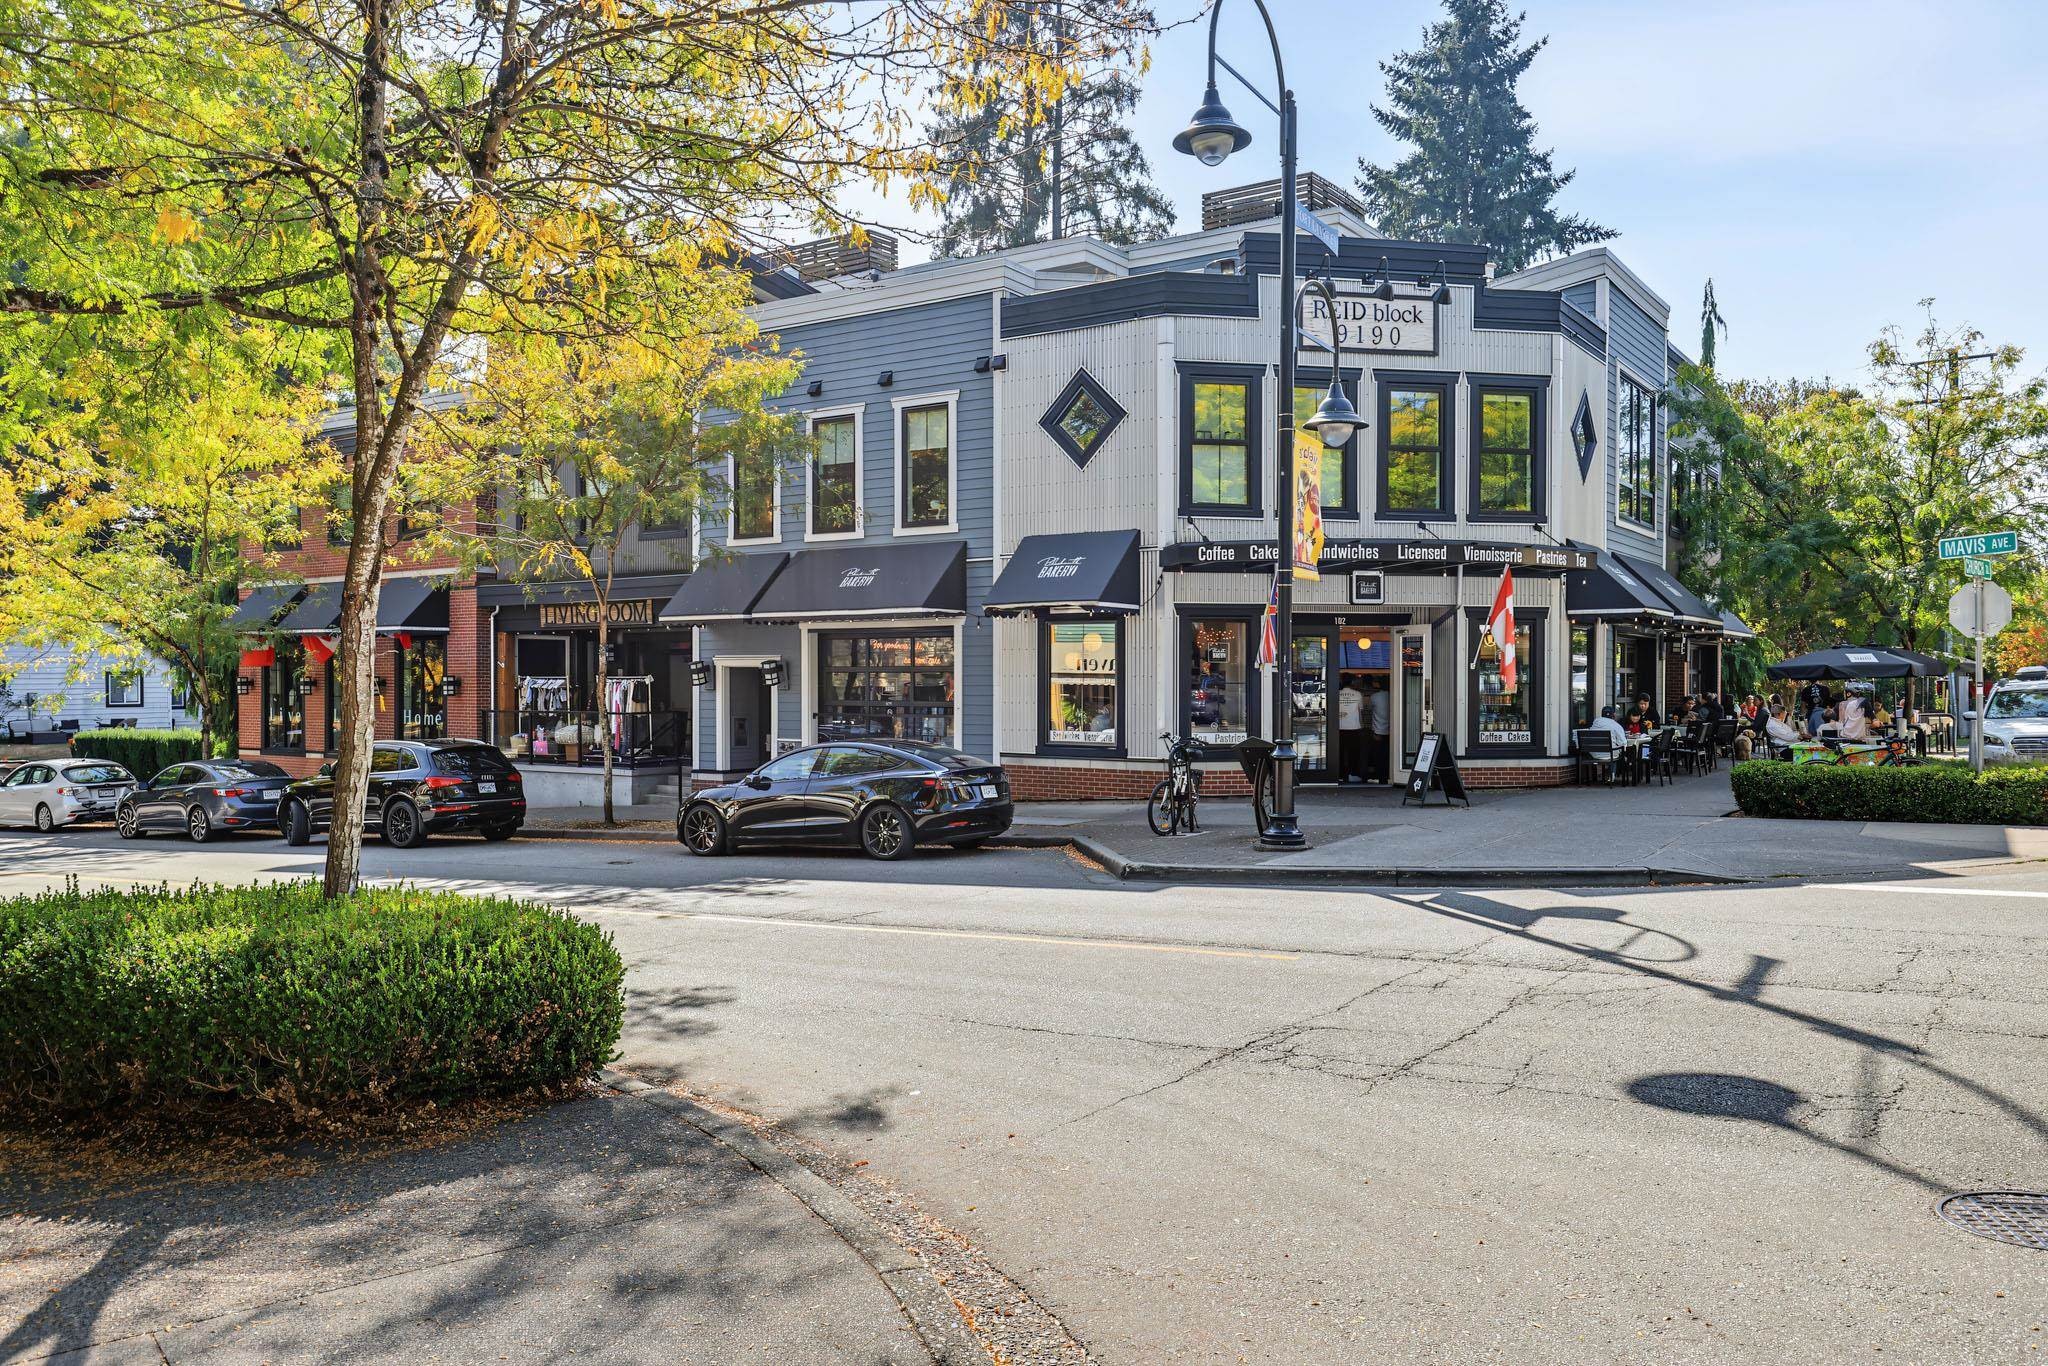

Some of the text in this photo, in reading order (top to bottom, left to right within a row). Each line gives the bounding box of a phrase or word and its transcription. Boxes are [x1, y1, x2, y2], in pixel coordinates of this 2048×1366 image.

[1373, 303, 1424, 323] block
[1338, 324, 1400, 346] 9190
[1198, 544, 1587, 567] Coffee Cake ndwiches Licensed Vienoisserie Pastries Tea
[1945, 537, 2012, 556] MAVIS AVE.
[1334, 617, 1346, 625] 102
[403, 709, 442, 726] Home
[1214, 733, 1246, 743] Pastries
[1480, 732, 1530, 742] Coffee Cakes
